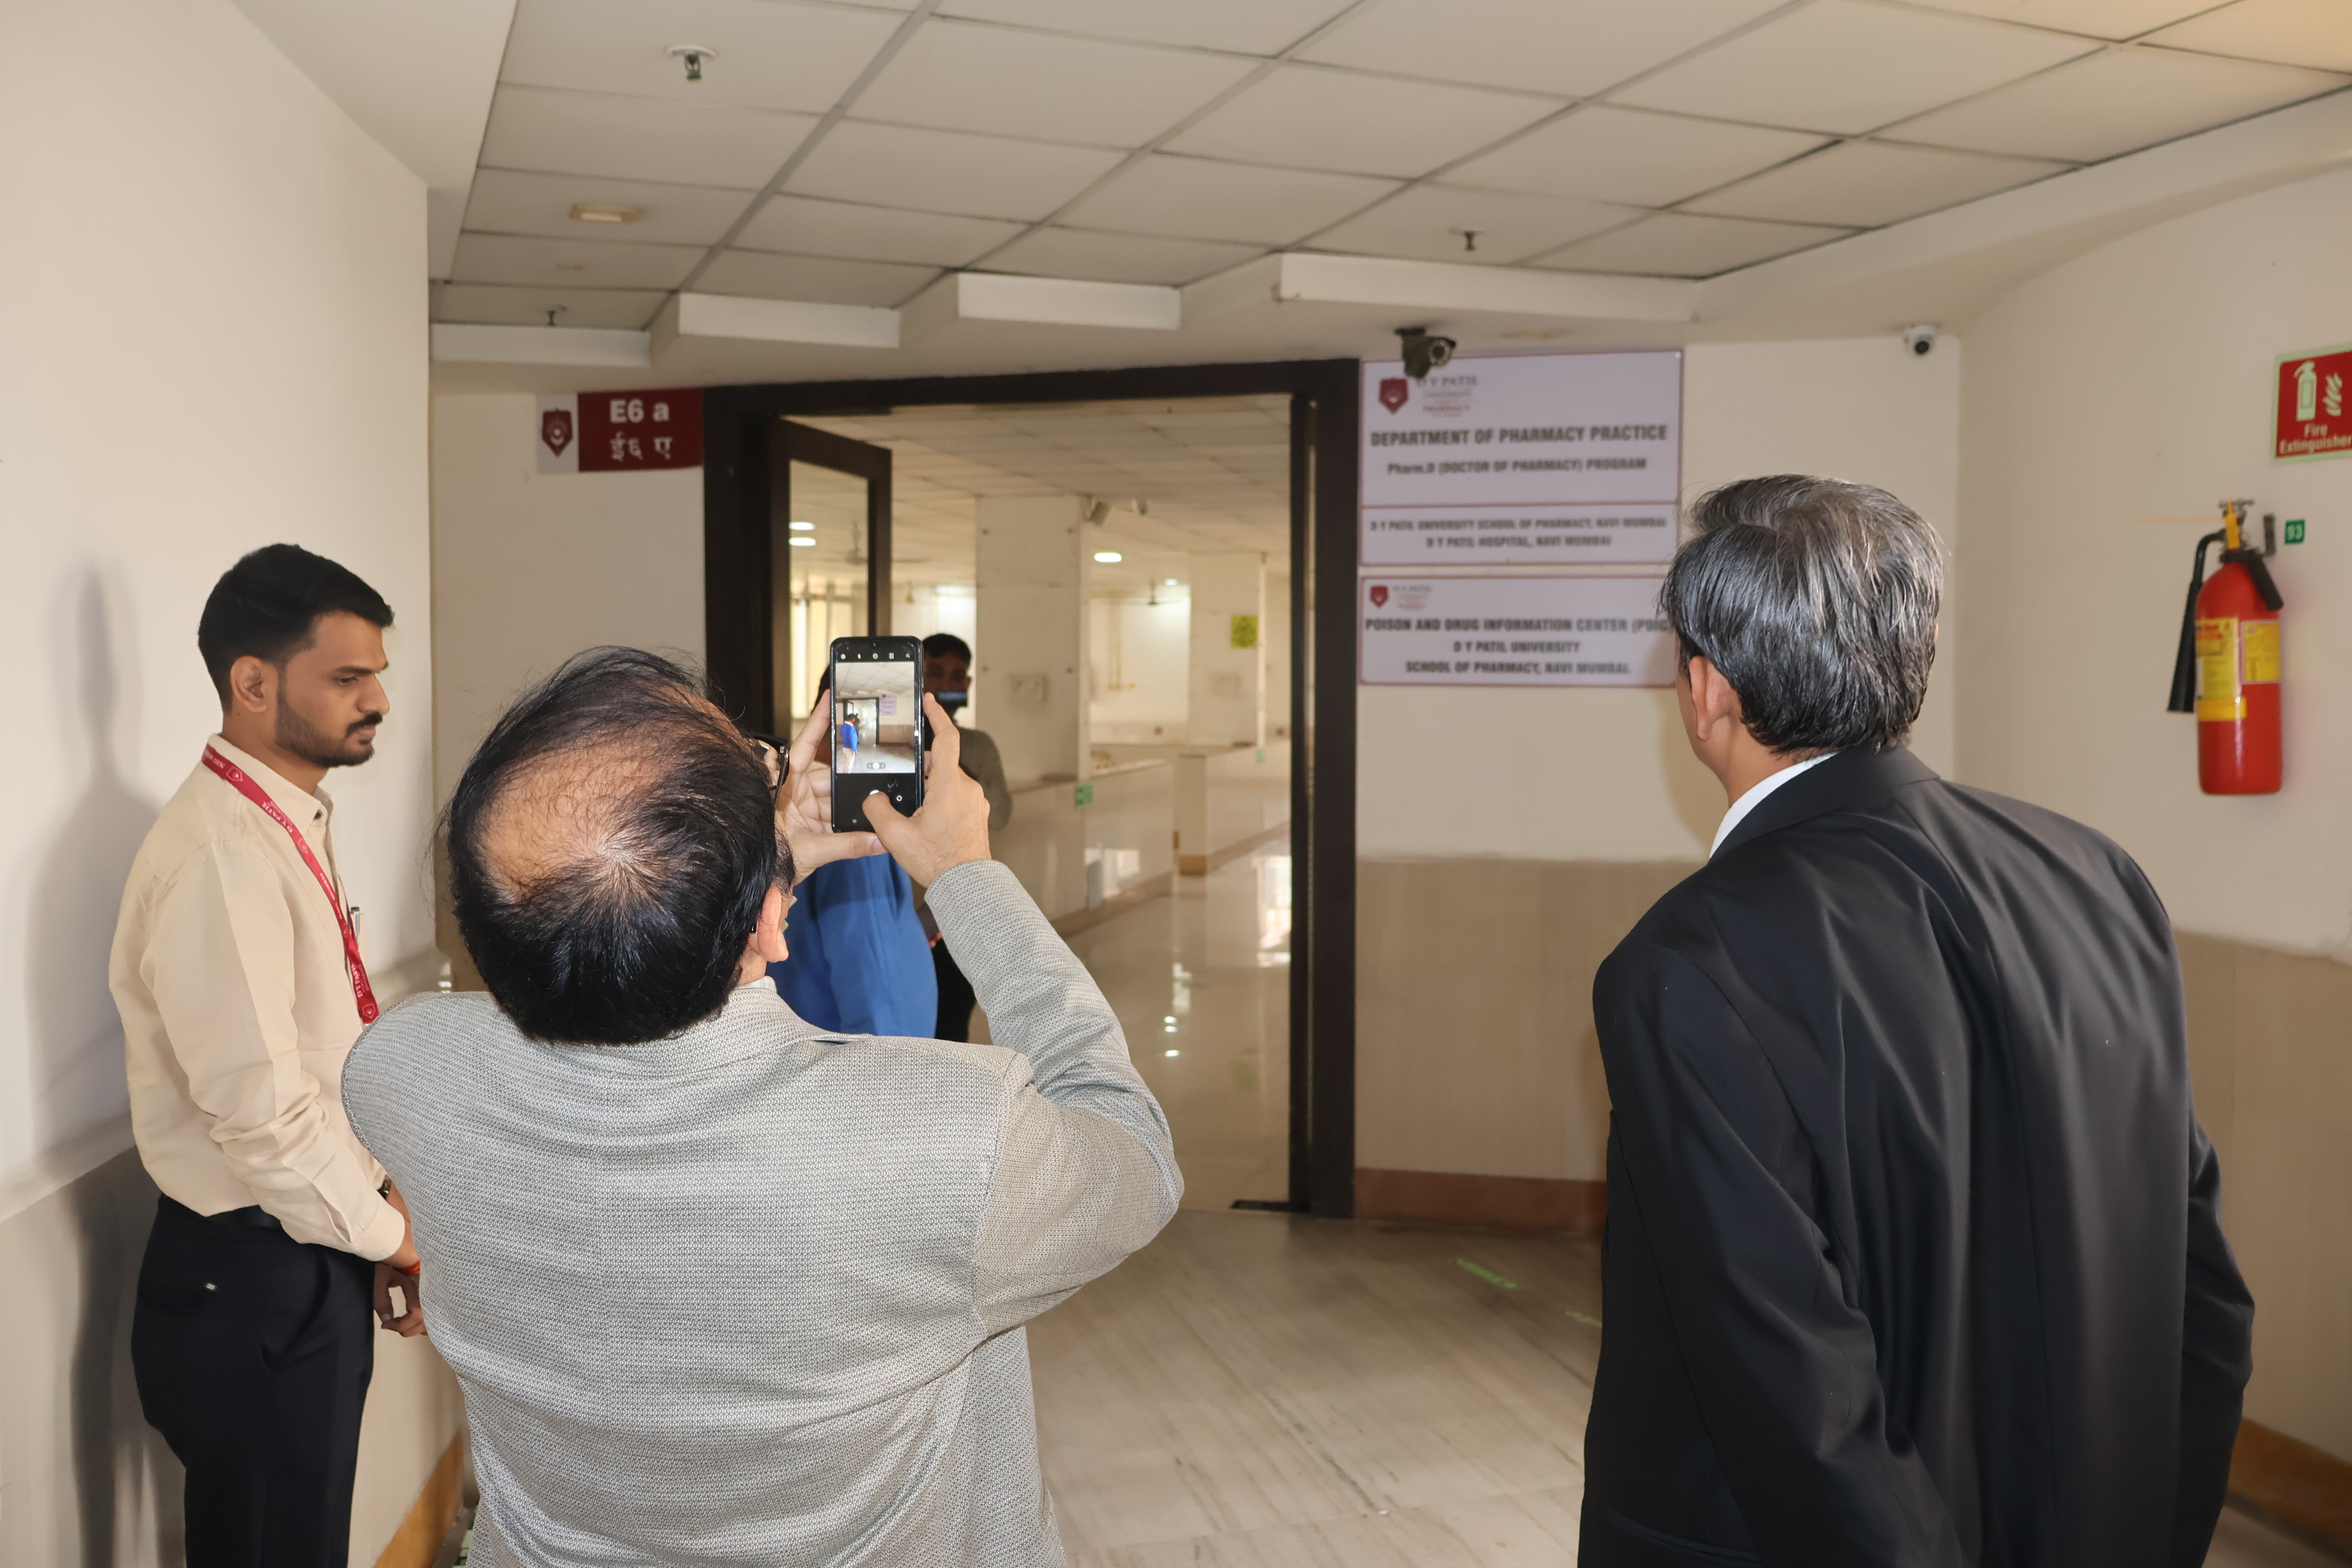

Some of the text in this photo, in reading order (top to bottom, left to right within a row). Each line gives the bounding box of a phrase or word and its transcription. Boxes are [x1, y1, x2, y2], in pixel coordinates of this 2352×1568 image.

[1441, 375, 1477, 387] PATIL
[610, 398, 670, 423] E6 a
[1370, 425, 1667, 446] DEPARTMENT OF PHARMACY PRACTICE
[2304, 423, 2328, 438] Fire
[2279, 434, 2352, 455] Extinguisher
[1387, 457, 1646, 475] Pharm.D (DOCTOR OF PHARMACY) PROGRAM
[1388, 520, 1413, 531] PATIL
[1417, 519, 1474, 530] UNIVERSITY
[1477, 519, 1514, 530] SCHOOL
[1519, 519, 1532, 529] OF
[1595, 517, 1620, 528] NAVI
[1426, 537, 1433, 548] D
[1436, 537, 1443, 548] Y
[1446, 536, 1474, 548] PATIL
[1536, 535, 1562, 546] NAVI
[1366, 618, 1411, 632] POISON
[1415, 618, 1441, 632] AND
[1445, 618, 1479, 632] DRUG
[1483, 618, 1572, 632] INFORMATION
[1576, 618, 1628, 632] CENTER
[1453, 640, 1580, 653] D Y PATIL UNIVERSITY
[1406, 661, 1451, 673] SCHOOL
[1455, 661, 1470, 673] OF
[1473, 661, 1541, 675] PHARMACY,
[1544, 662, 1573, 673] NAVI
